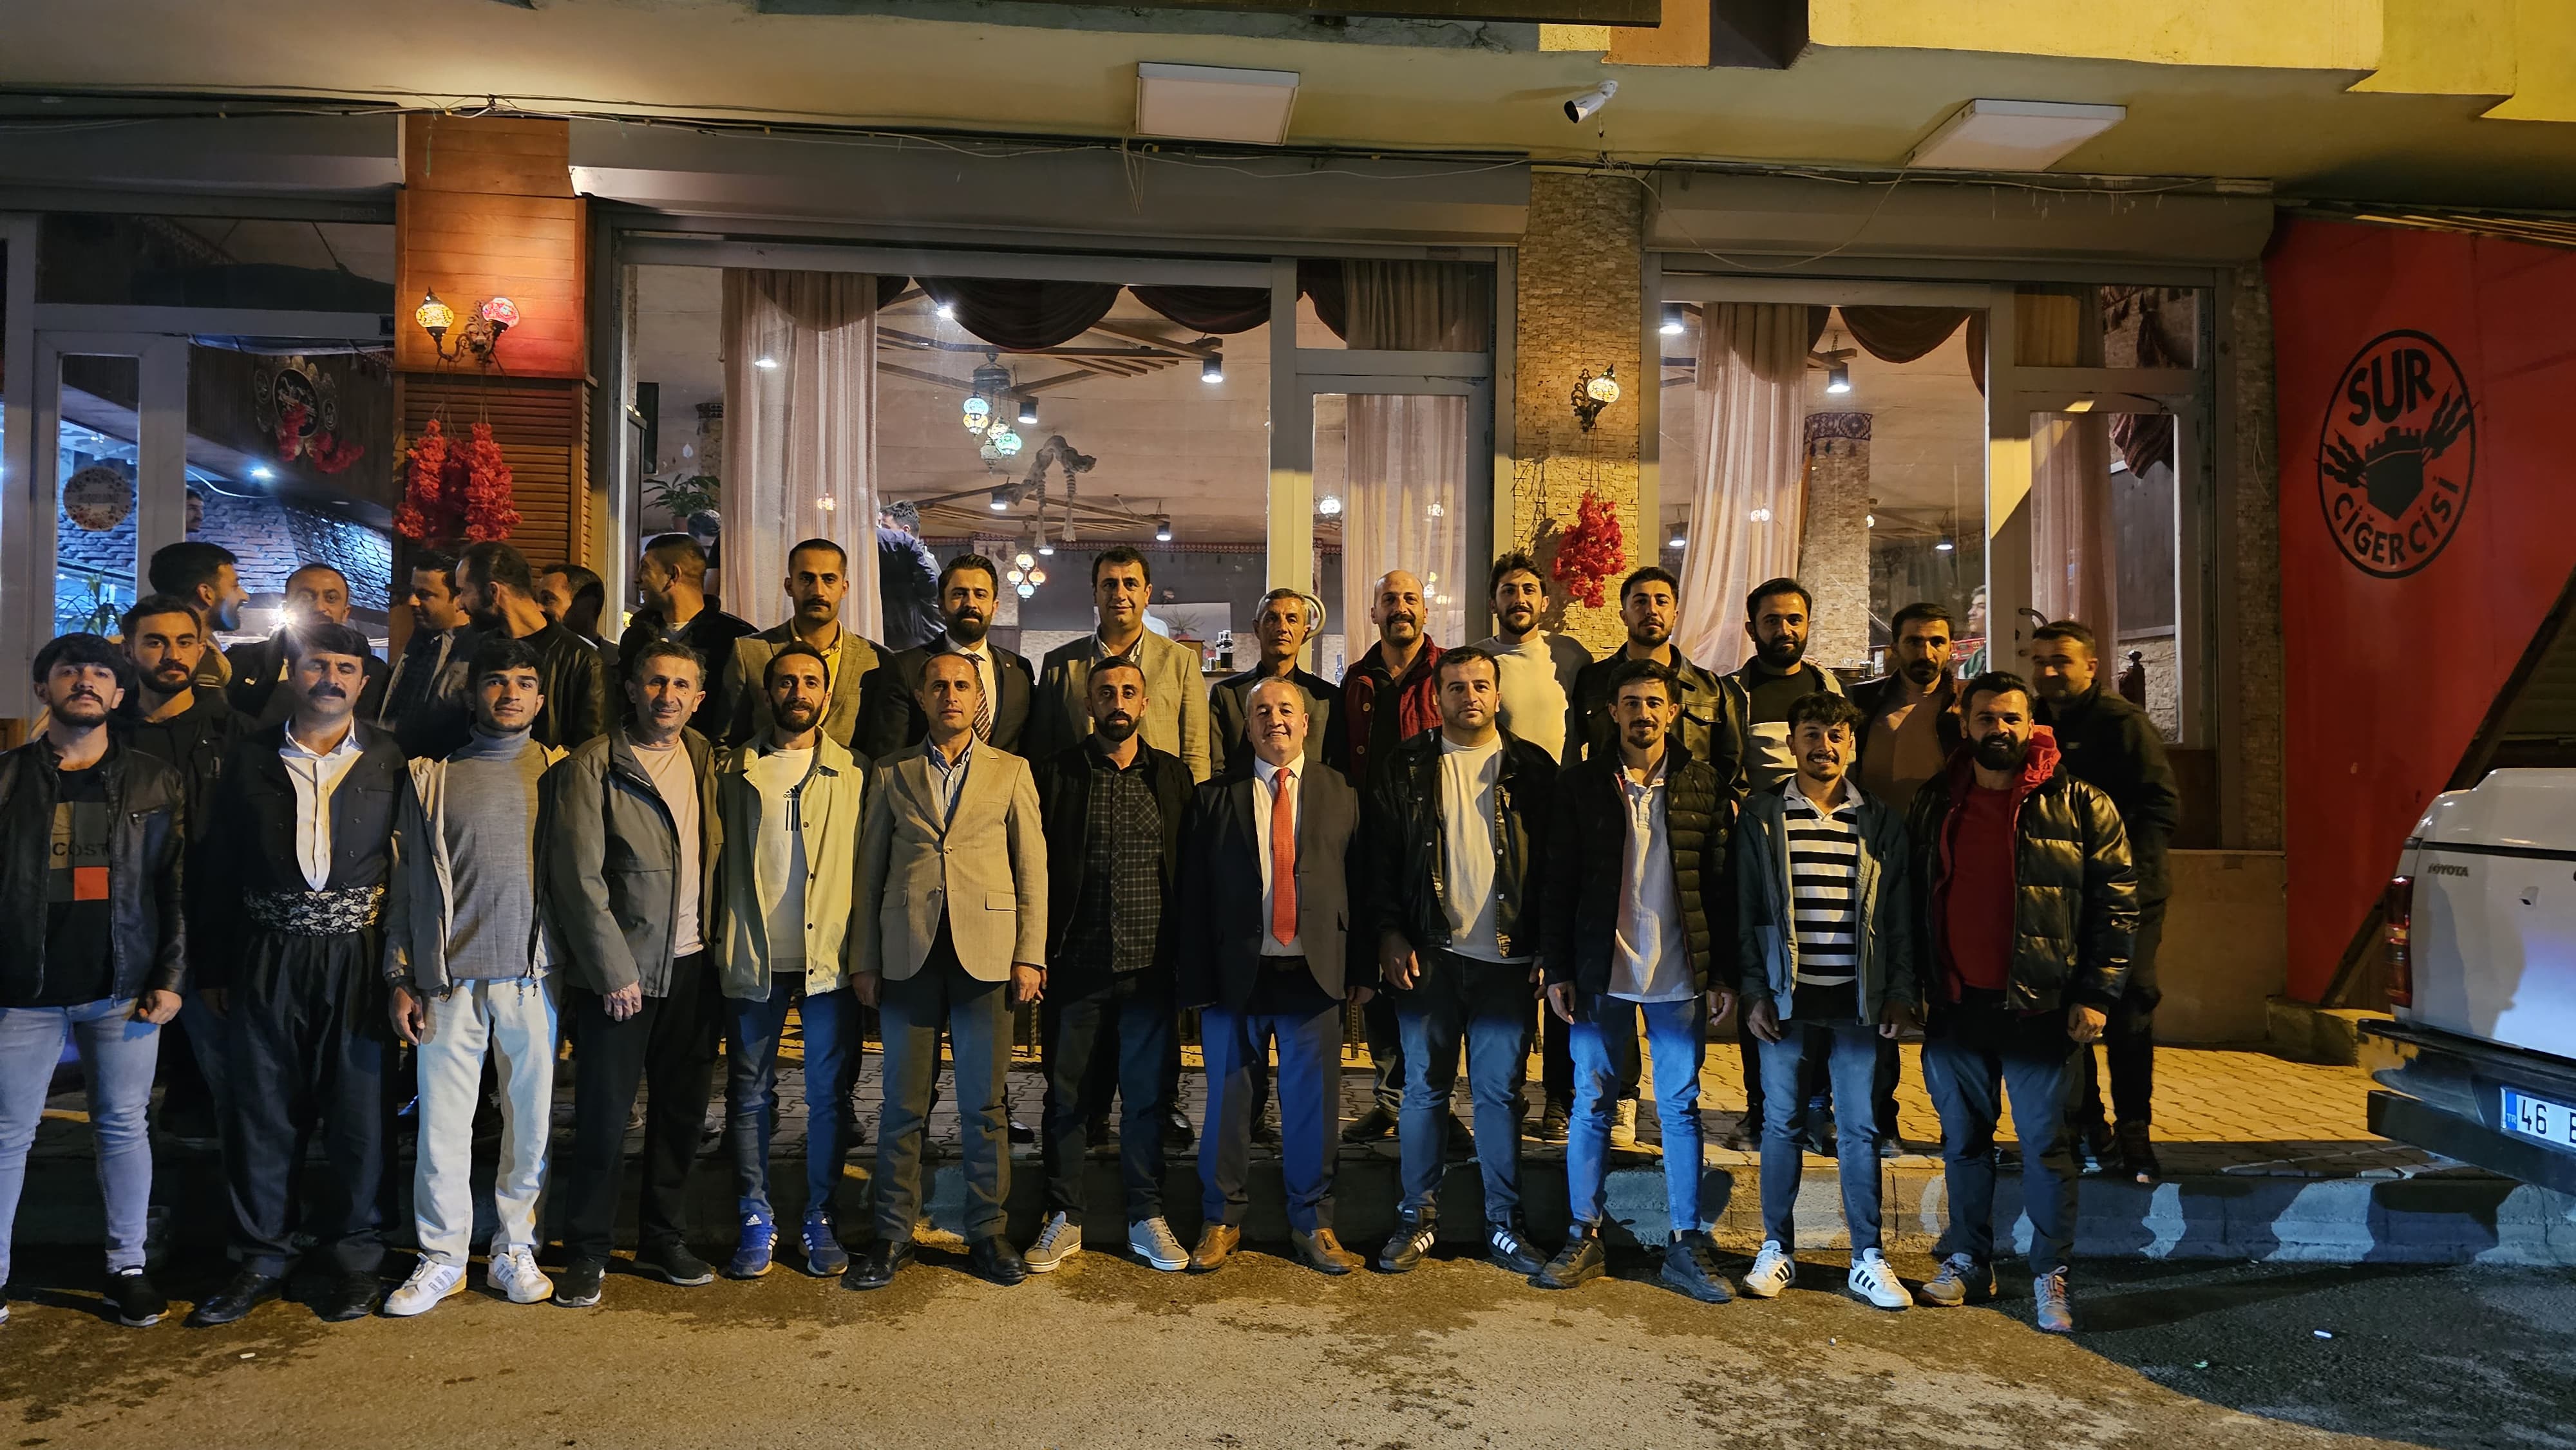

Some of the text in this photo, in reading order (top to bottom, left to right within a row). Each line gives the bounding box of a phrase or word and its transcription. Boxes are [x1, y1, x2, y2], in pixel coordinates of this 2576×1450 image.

[2348, 349, 2435, 426] SUR
[2427, 863, 2468, 876] TOYOTA
[2506, 1113, 2517, 1124] TR
[2522, 1100, 2546, 1135] 46
